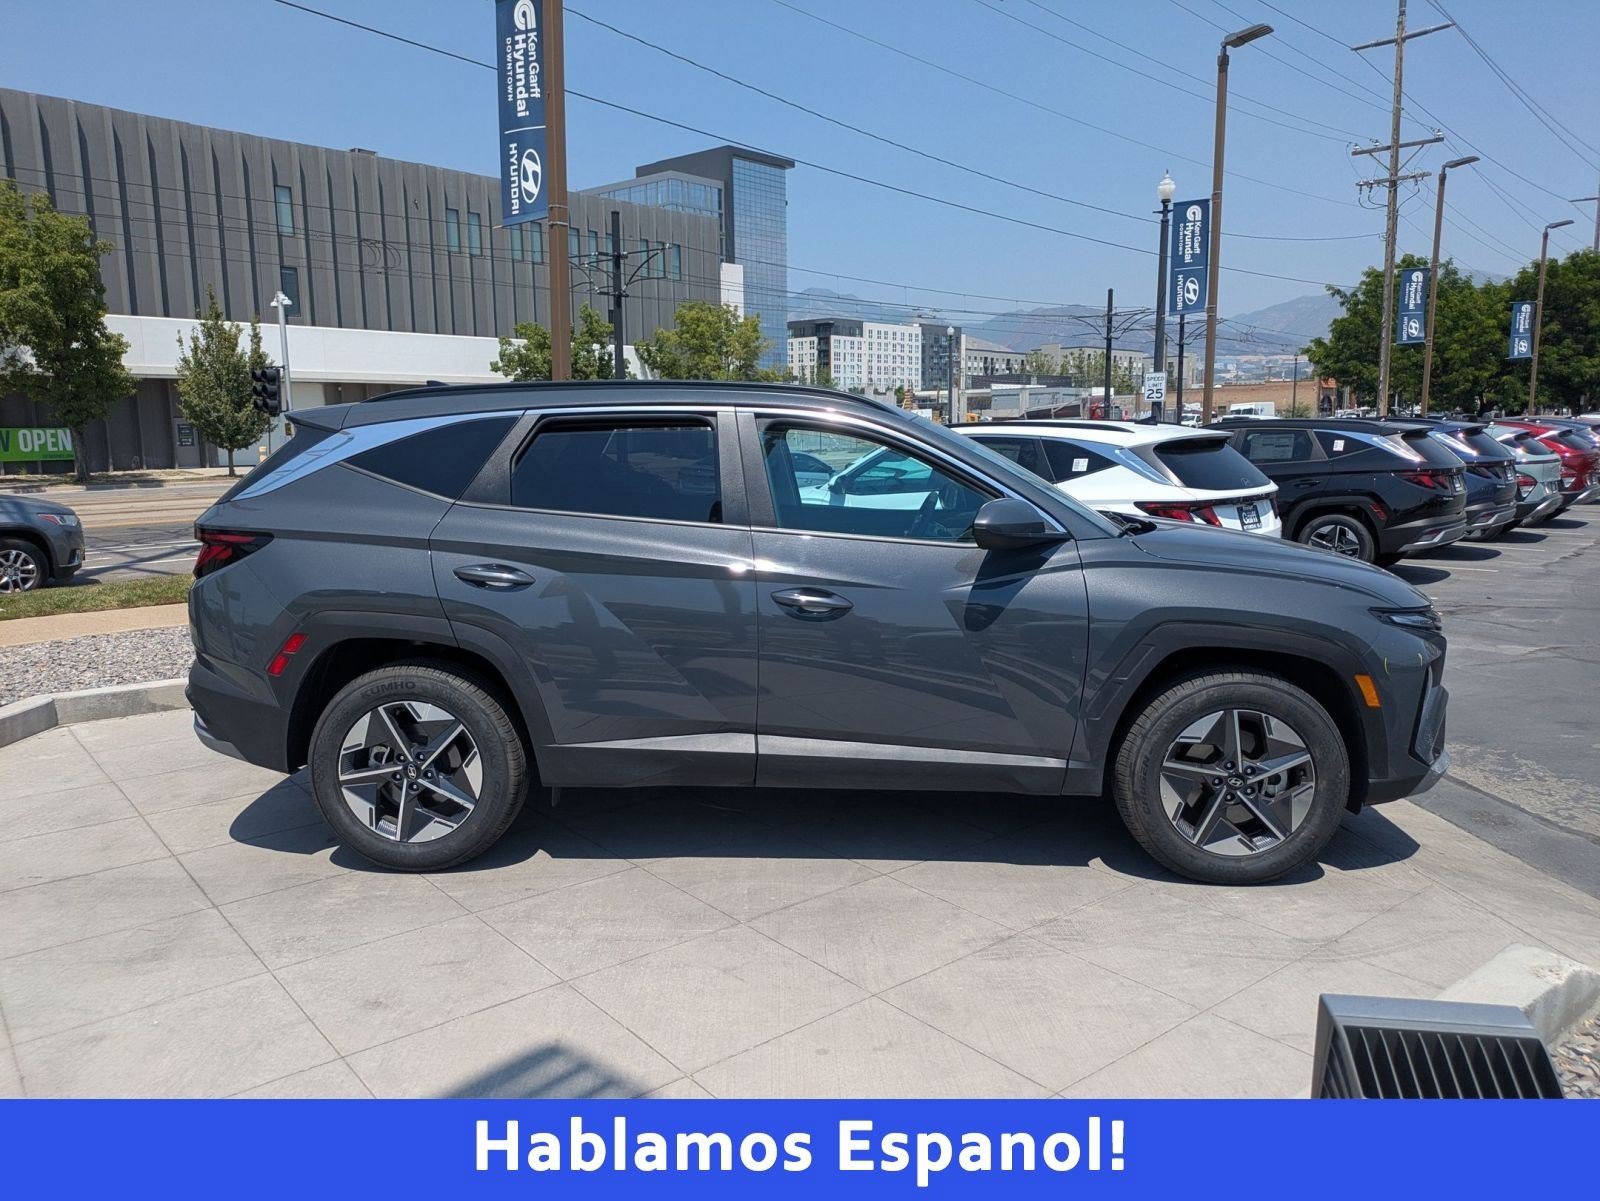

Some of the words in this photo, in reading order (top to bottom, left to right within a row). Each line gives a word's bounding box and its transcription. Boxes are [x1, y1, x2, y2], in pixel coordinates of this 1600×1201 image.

[527, 31, 538, 61] Ken
[513, 33, 529, 117] Hyundai
[528, 62, 541, 98] Garff
[509, 143, 519, 215] HYUNDAI
[1184, 222, 1194, 263] Hyundai
[1176, 274, 1184, 311] HYUNDAI
[1146, 388, 1163, 399] 25
[18, 429, 73, 453] OPEN
[360, 681, 416, 697] KUMHO
